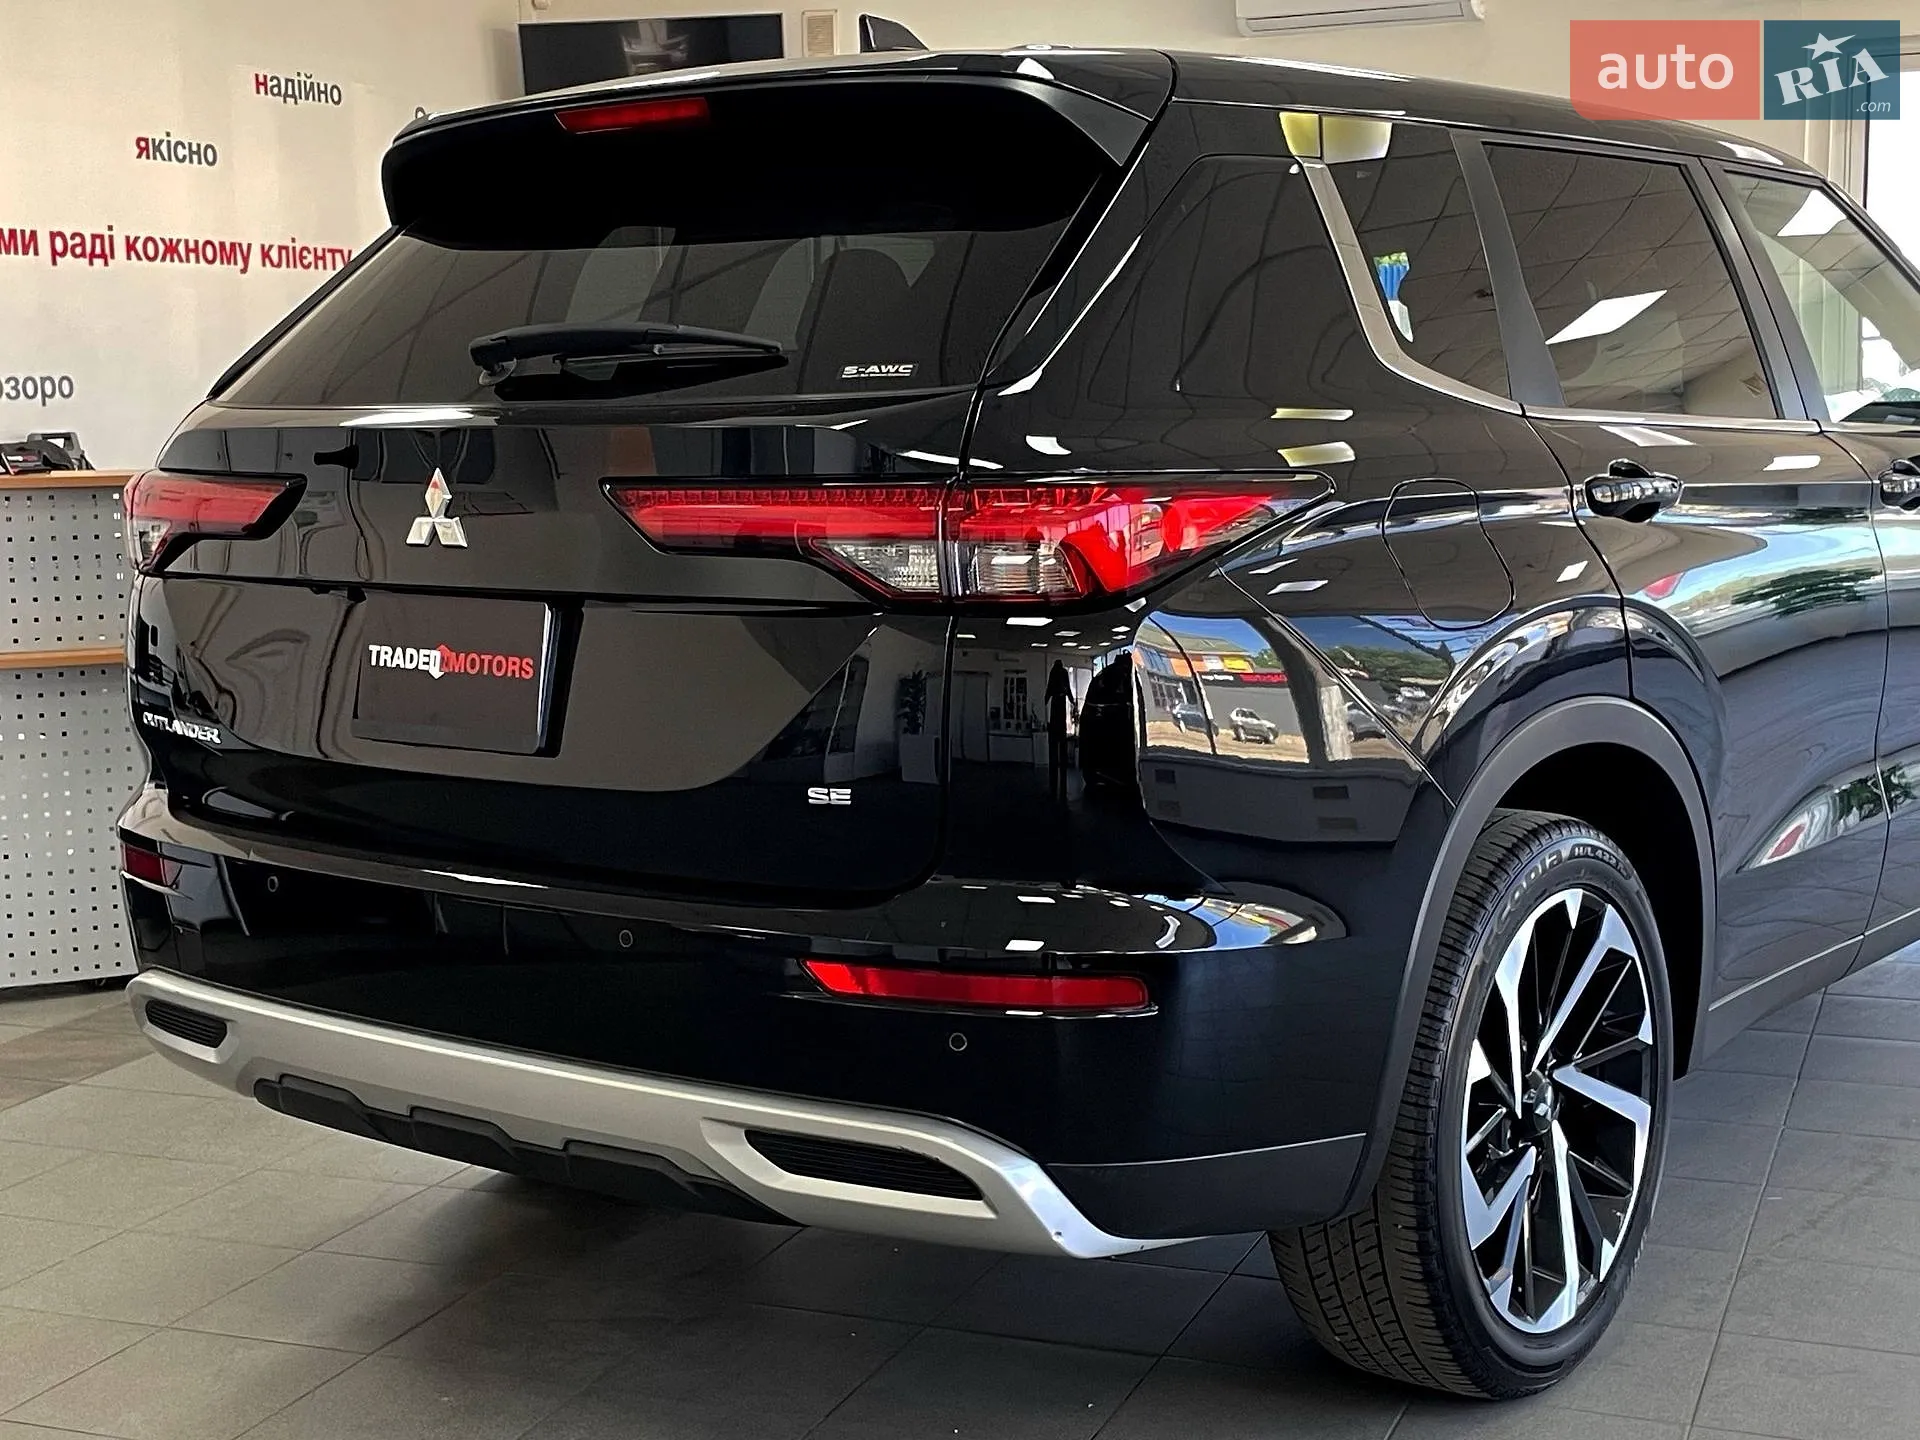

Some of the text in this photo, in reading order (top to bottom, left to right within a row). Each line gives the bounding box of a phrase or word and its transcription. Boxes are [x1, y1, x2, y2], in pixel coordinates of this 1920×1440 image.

[254, 71, 342, 106] надійно
[135, 131, 218, 167] якісно
[0, 227, 39, 256] ми
[49, 224, 115, 267] раді
[125, 235, 252, 274] кожному
[843, 364, 914, 375] S-AWC
[0, 375, 74, 407] зоро
[807, 787, 852, 805] SE
